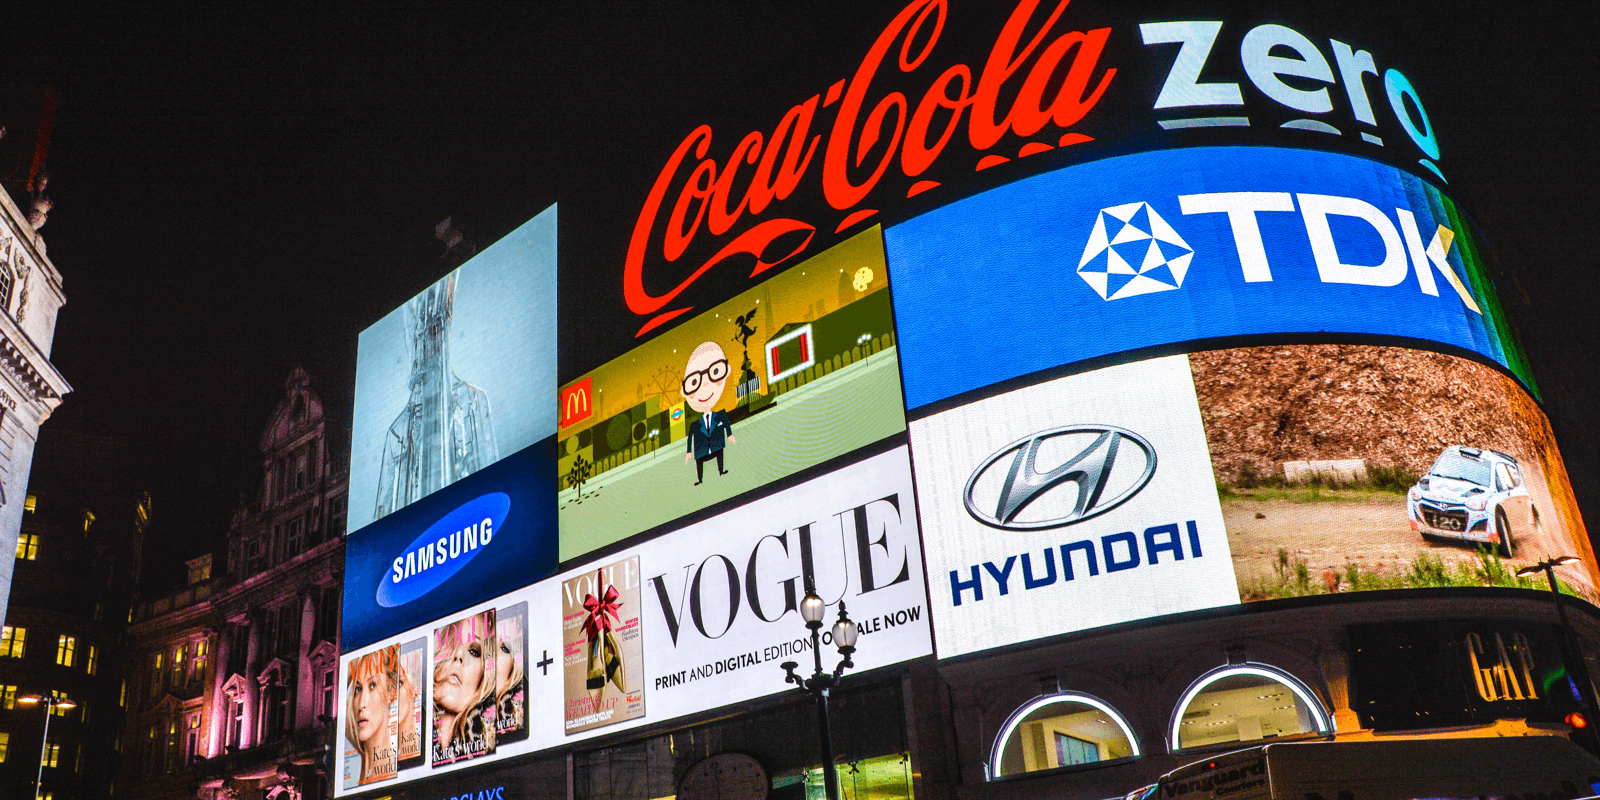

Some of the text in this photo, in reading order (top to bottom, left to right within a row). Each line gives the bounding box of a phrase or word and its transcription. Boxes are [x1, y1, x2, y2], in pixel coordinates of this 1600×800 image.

[623, 0, 1440, 315] Coca-Cola zero
[1178, 191, 1483, 315] TDK
[392, 518, 493, 583] SAMSUNG
[648, 493, 909, 648] VOGUE
[950, 520, 1203, 606] HYUNDAI
[564, 558, 639, 608] VOGUE
[436, 609, 495, 652] VOGUE
[655, 671, 687, 690] PRINT
[690, 664, 713, 682] AND
[715, 651, 761, 674] DIGITAL
[764, 636, 817, 661] EDITION
[855, 617, 881, 635] ALE
[884, 605, 920, 629] NOW
[350, 643, 399, 682] VOGUE
[1466, 632, 1540, 702] GAP
[373, 742, 396, 761] Kate's
[401, 728, 420, 743] Kate's
[402, 740, 420, 754] world
[433, 740, 460, 761] Kate's
[463, 733, 489, 753] world
[374, 757, 396, 775] world
[1164, 758, 1265, 797] Vanguard
[1216, 780, 1265, 795] Couriers
